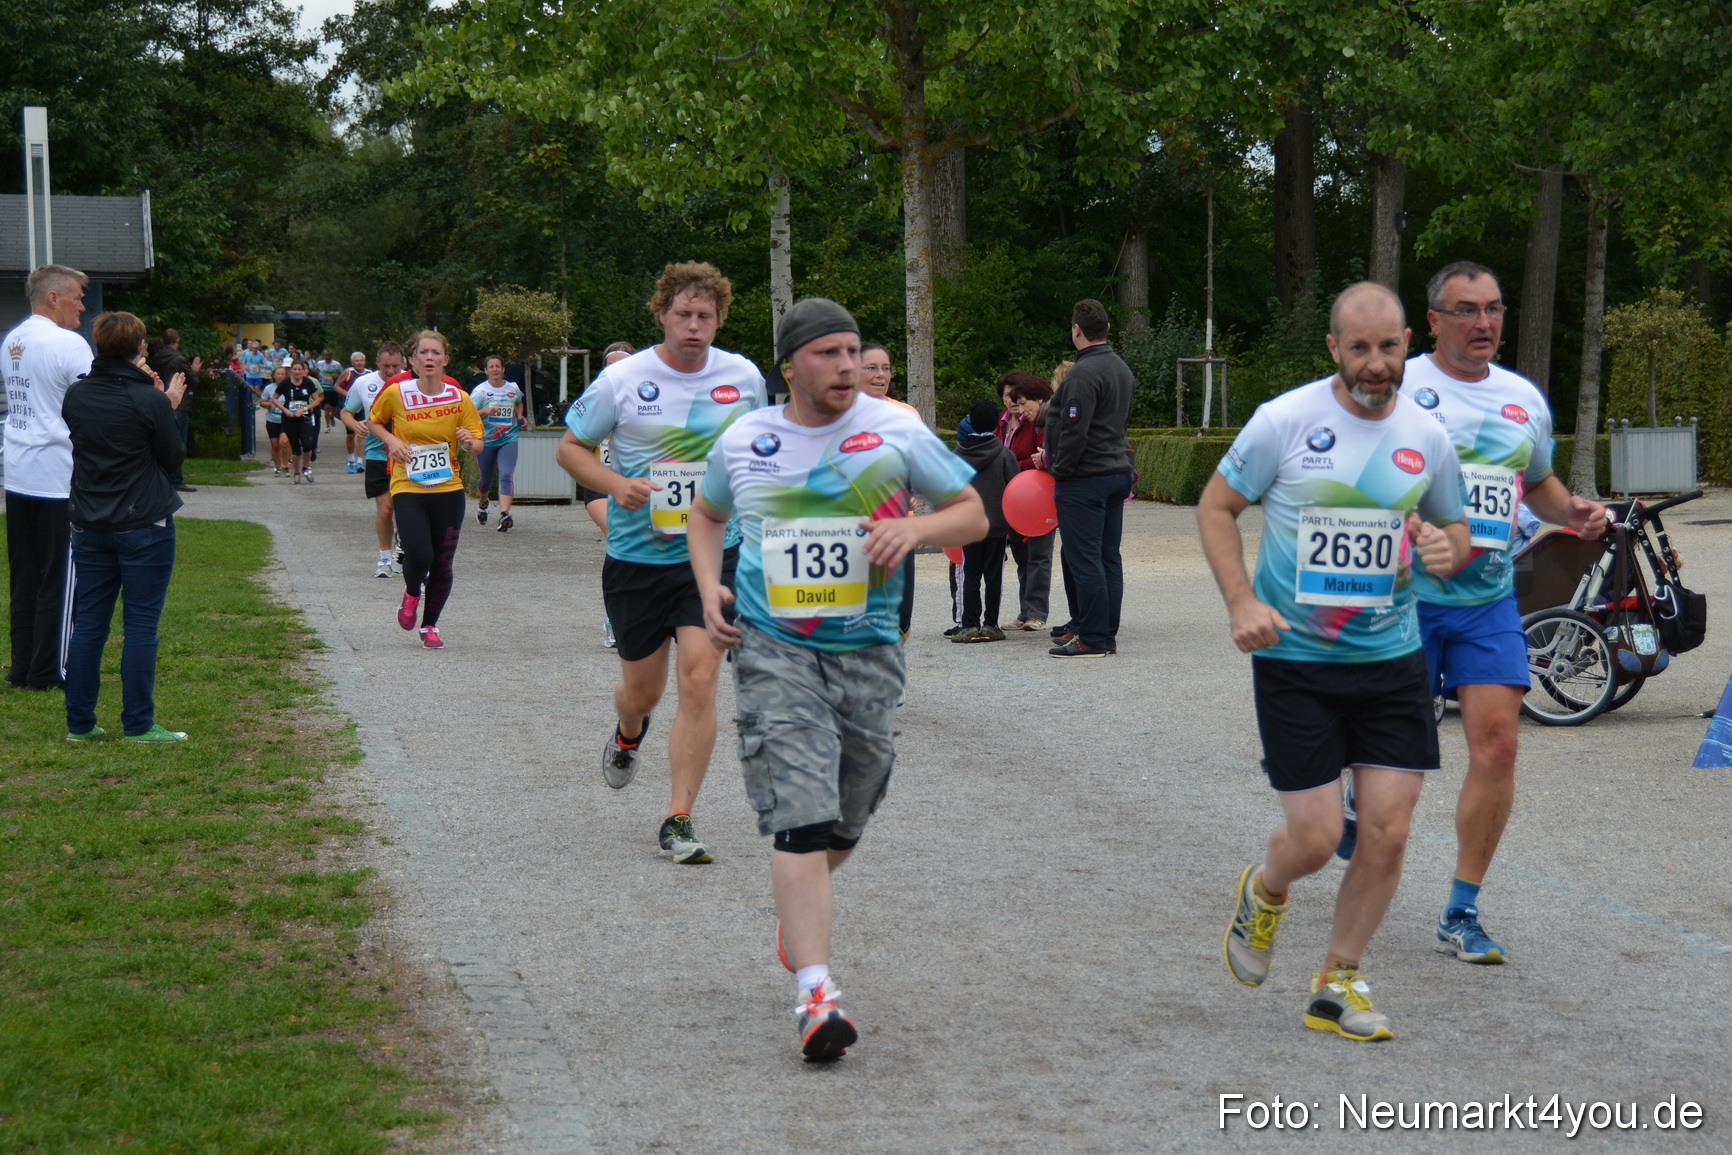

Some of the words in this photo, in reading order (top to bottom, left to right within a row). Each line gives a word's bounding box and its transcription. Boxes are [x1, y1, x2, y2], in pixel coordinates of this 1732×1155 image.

[7, 376, 30, 388] UFTRAG
[406, 411, 432, 422] MAX
[436, 405, 463, 418] BÖGL
[411, 452, 446, 472] 2735
[1301, 456, 1334, 465] PARTL
[423, 472, 440, 481] Sarah
[1471, 471, 1507, 482] Neumarkt
[667, 480, 695, 507] 31
[1468, 484, 1512, 518] 453
[1301, 515, 1336, 527] PARTL
[1338, 518, 1387, 529] Neumarkt
[1470, 523, 1497, 536] othar
[765, 529, 797, 538] PARTL
[800, 527, 851, 538] Neumarkt
[1309, 531, 1393, 569] 2630
[784, 542, 849, 579] 133
[1324, 576, 1373, 593] Markus
[796, 589, 836, 604] David
